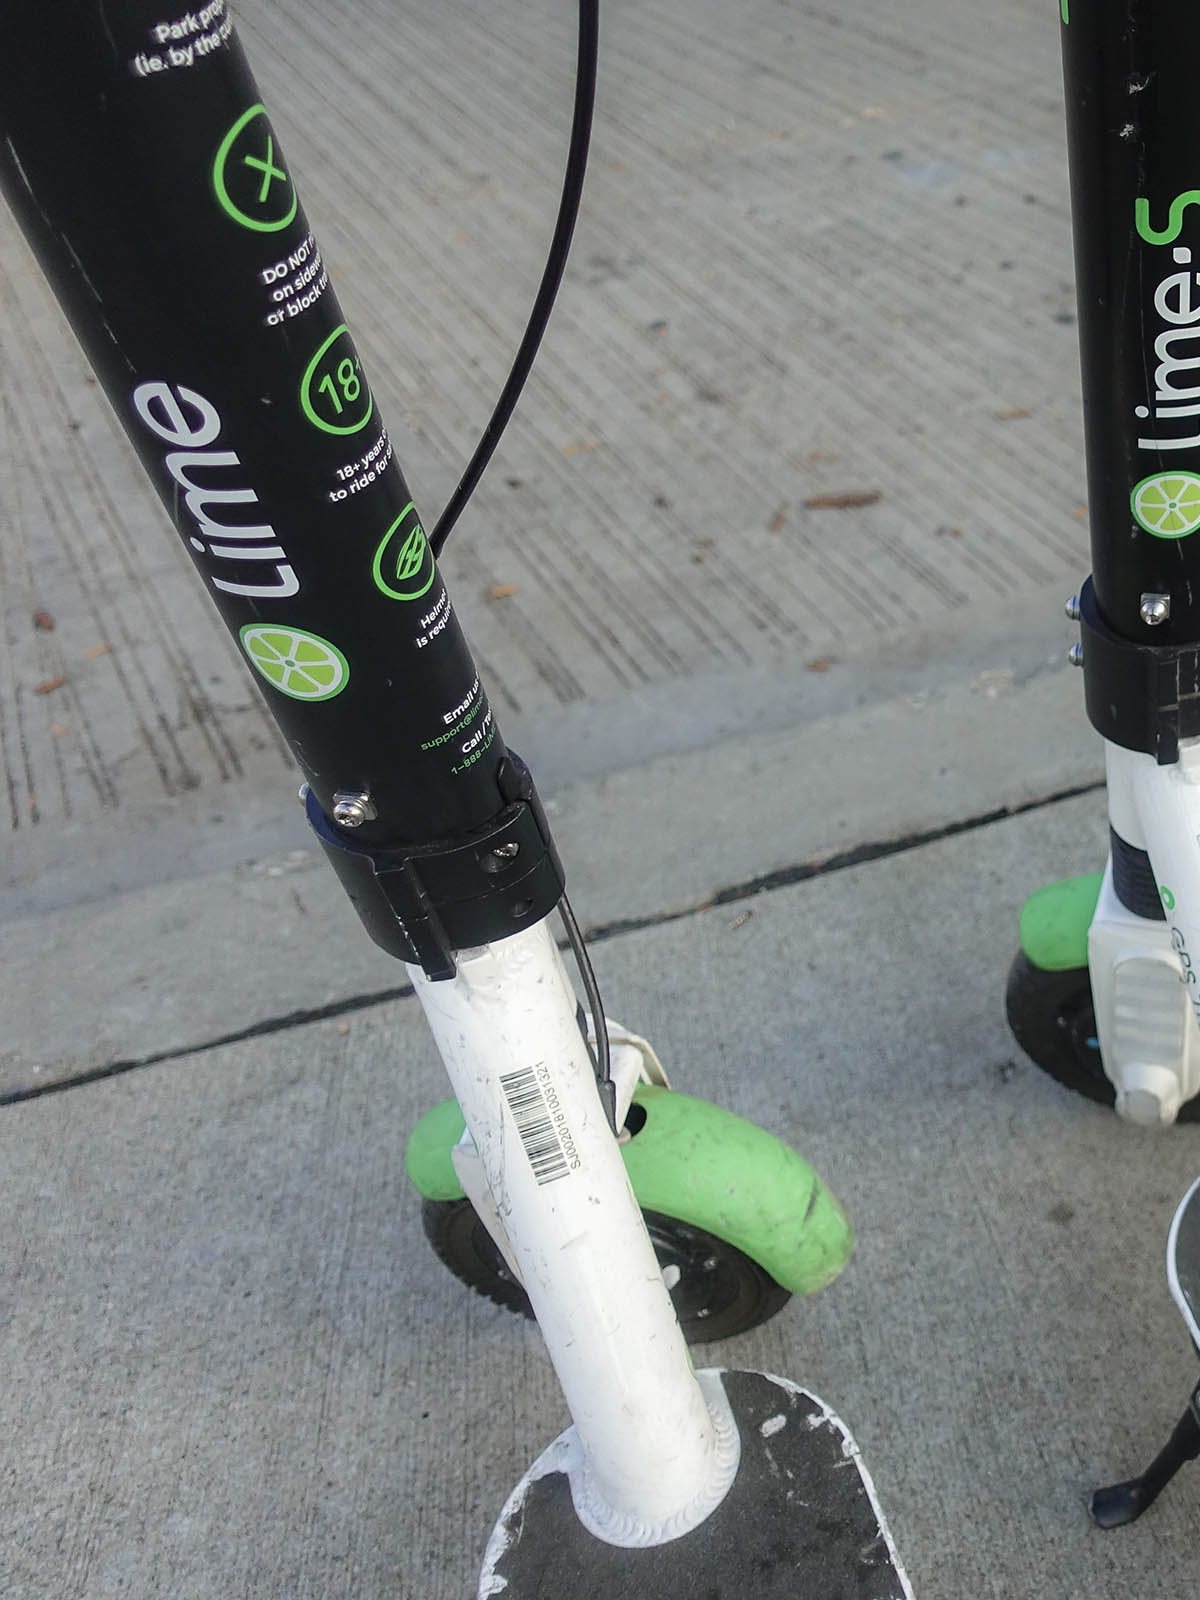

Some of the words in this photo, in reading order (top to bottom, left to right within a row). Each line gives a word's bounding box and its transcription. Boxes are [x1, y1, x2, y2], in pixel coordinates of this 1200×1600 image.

[155, 12, 200, 43] Park
[168, 44, 194, 66] by
[194, 34, 221, 56] the
[262, 263, 289, 284] DO
[288, 240, 311, 270] NOT
[267, 309, 285, 325] or
[287, 284, 321, 317] block
[273, 284, 294, 301] on
[329, 491, 348, 502] to
[350, 471, 376, 494] ride
[375, 454, 389, 475] for
[336, 463, 361, 481] 18+
[361, 436, 385, 470] years
[133, 382, 299, 598] Lime
[416, 634, 428, 649] is
[443, 691, 474, 725] Email
[1171, 926, 1197, 986] GPS
